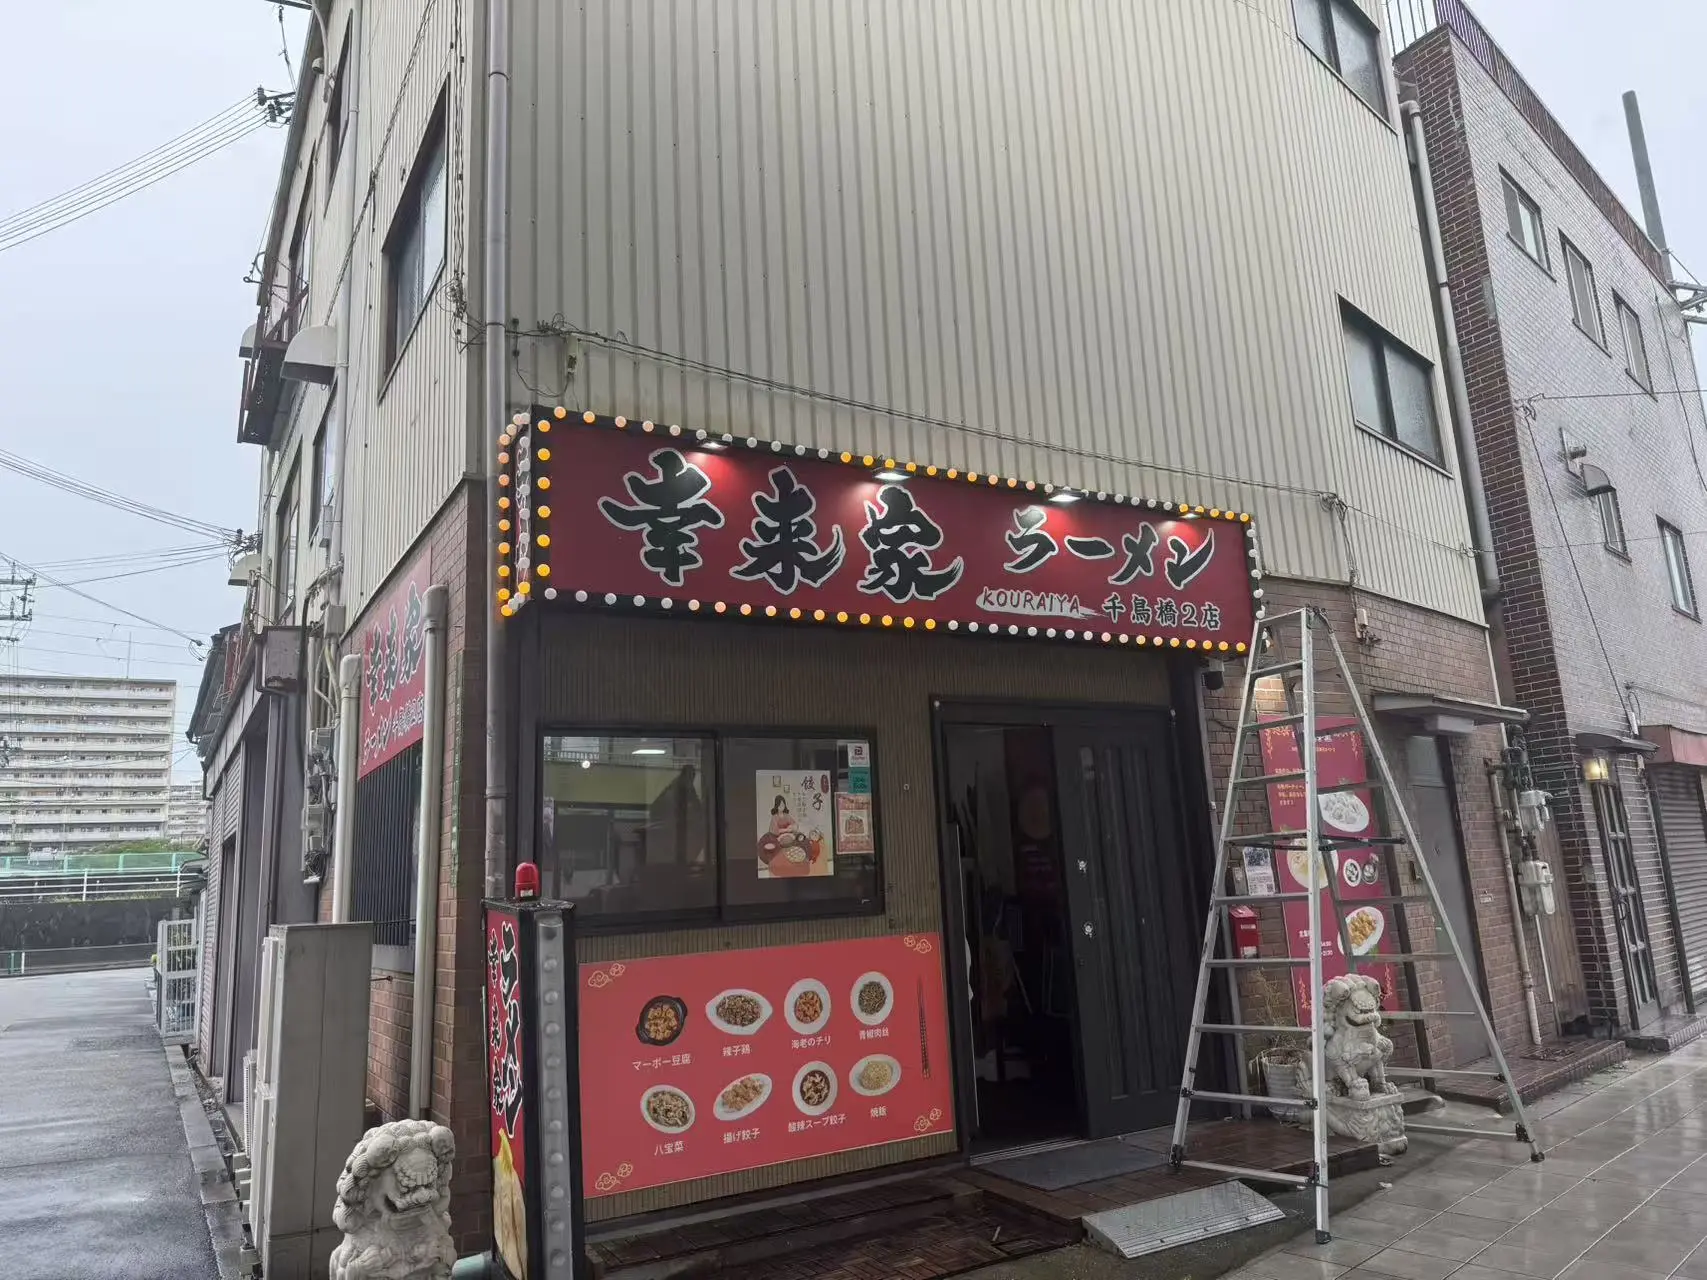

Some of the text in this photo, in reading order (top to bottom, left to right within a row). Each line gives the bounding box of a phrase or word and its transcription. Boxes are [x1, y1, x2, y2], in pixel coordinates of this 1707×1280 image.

[598, 447, 964, 603] 幸来家
[1003, 505, 1215, 591] ラーメン
[982, 587, 1081, 615] KOURAIYA
[1101, 591, 1222, 631] 千鳥橋2店
[654, 1140, 685, 1156] 八宝菜
